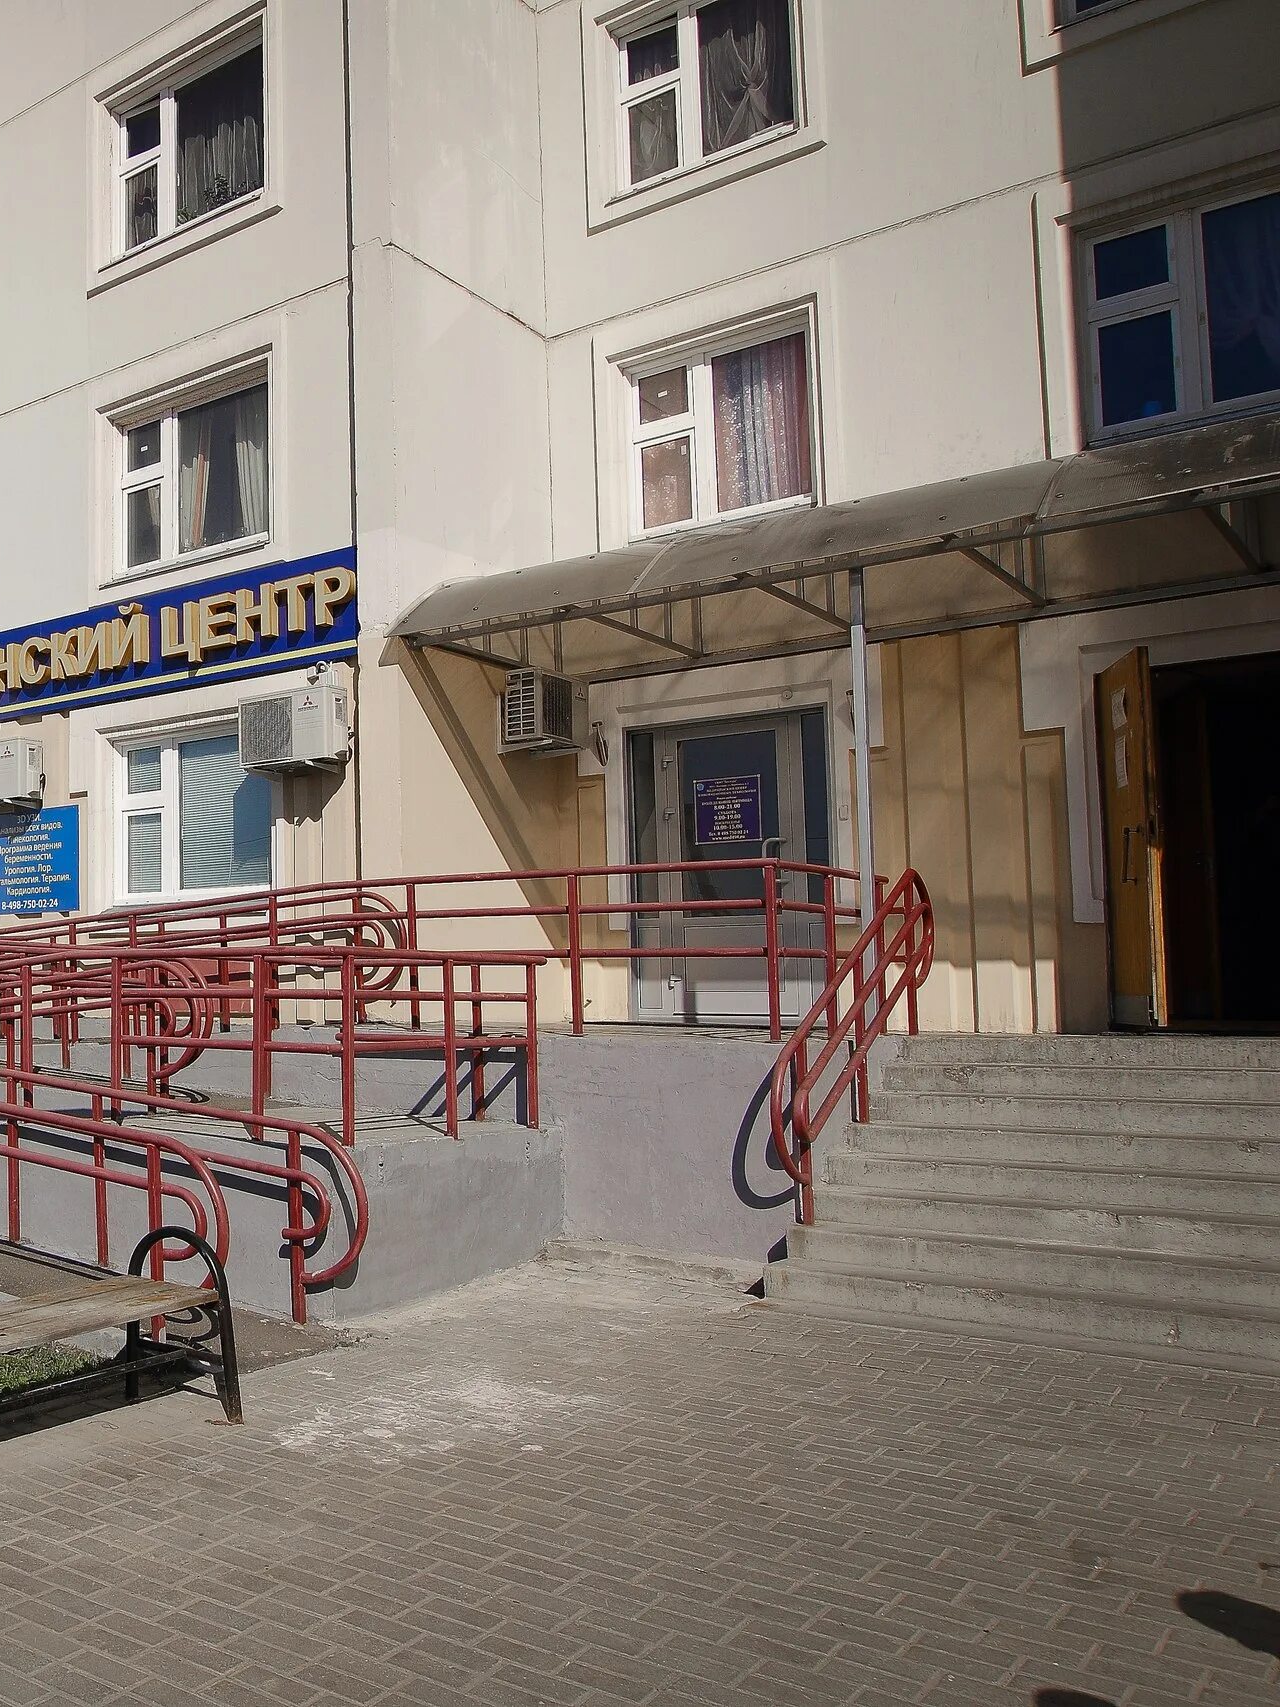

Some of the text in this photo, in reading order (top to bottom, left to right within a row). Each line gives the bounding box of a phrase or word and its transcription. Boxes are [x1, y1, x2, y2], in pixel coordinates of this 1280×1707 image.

[160, 566, 356, 663] ЦЕНТР
[25, 824, 40, 832] всех
[40, 821, 63, 831] видов.
[7, 833, 50, 845] Гинекология.
[33, 841, 62, 852] ведения
[4, 853, 53, 865] беременности.
[4, 863, 53, 876] Урология. Лор.
[41, 874, 71, 884] Терапия.
[6, 886, 52, 897] Кардиология.
[1, 898, 58, 910] 8-498-750-02-24
